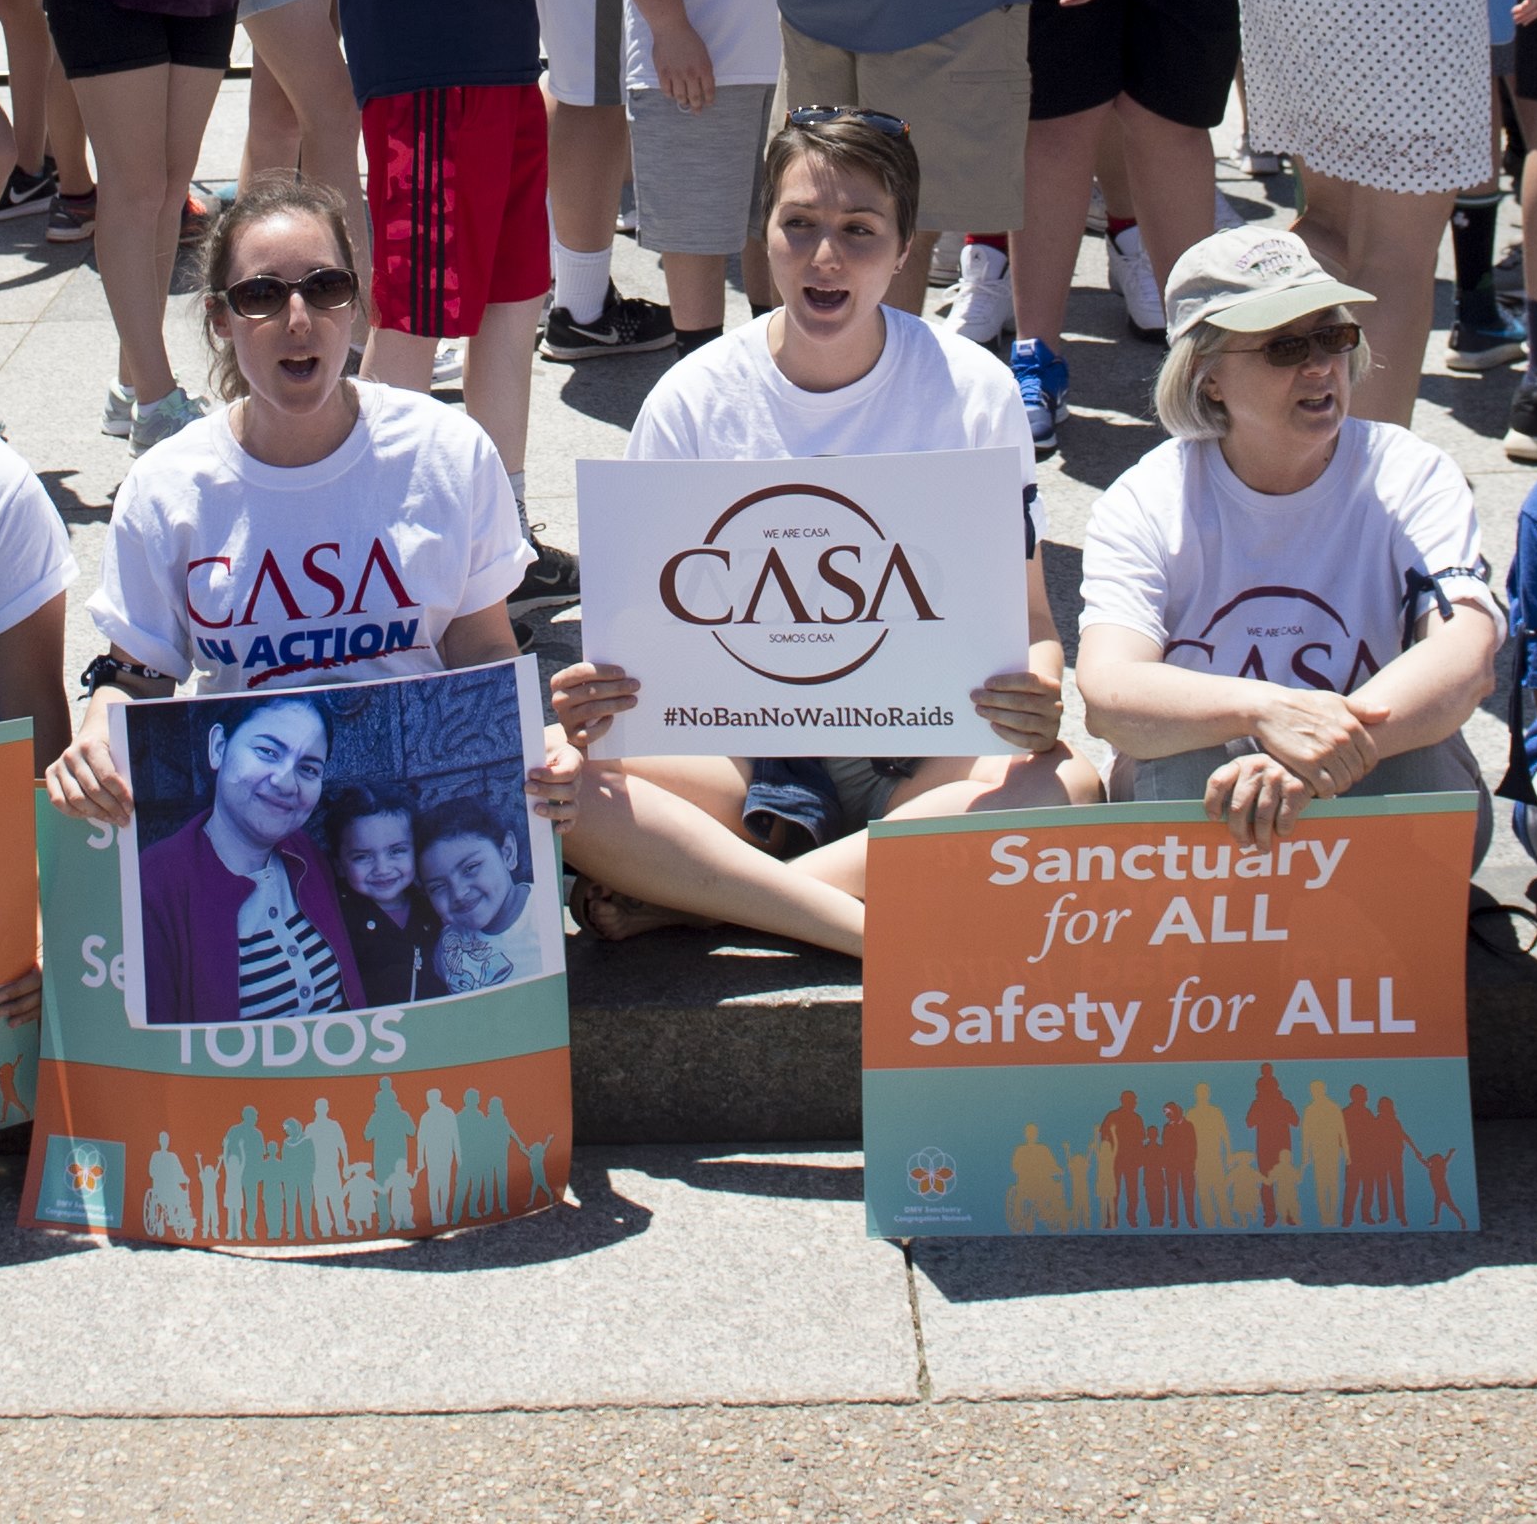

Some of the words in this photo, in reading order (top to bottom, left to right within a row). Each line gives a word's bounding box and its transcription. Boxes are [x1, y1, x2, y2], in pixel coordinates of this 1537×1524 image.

[763, 529, 779, 539] WE
[782, 529, 801, 539] ARE
[802, 528, 831, 538] CASA
[187, 537, 420, 630] CASA
[658, 543, 945, 626] CASA
[196, 637, 238, 666] IN
[242, 618, 420, 670] ACTION
[769, 634, 806, 643] SOMOS
[808, 633, 835, 643] CASA
[663, 706, 955, 728] #NoBanNoWallNoRaids
[988, 834, 1351, 890] Sanctuary
[1026, 892, 1133, 965] for
[1148, 894, 1289, 946] ALL
[909, 984, 1142, 1059] Safety
[1153, 976, 1256, 1054] for
[1275, 977, 1417, 1037] ALL
